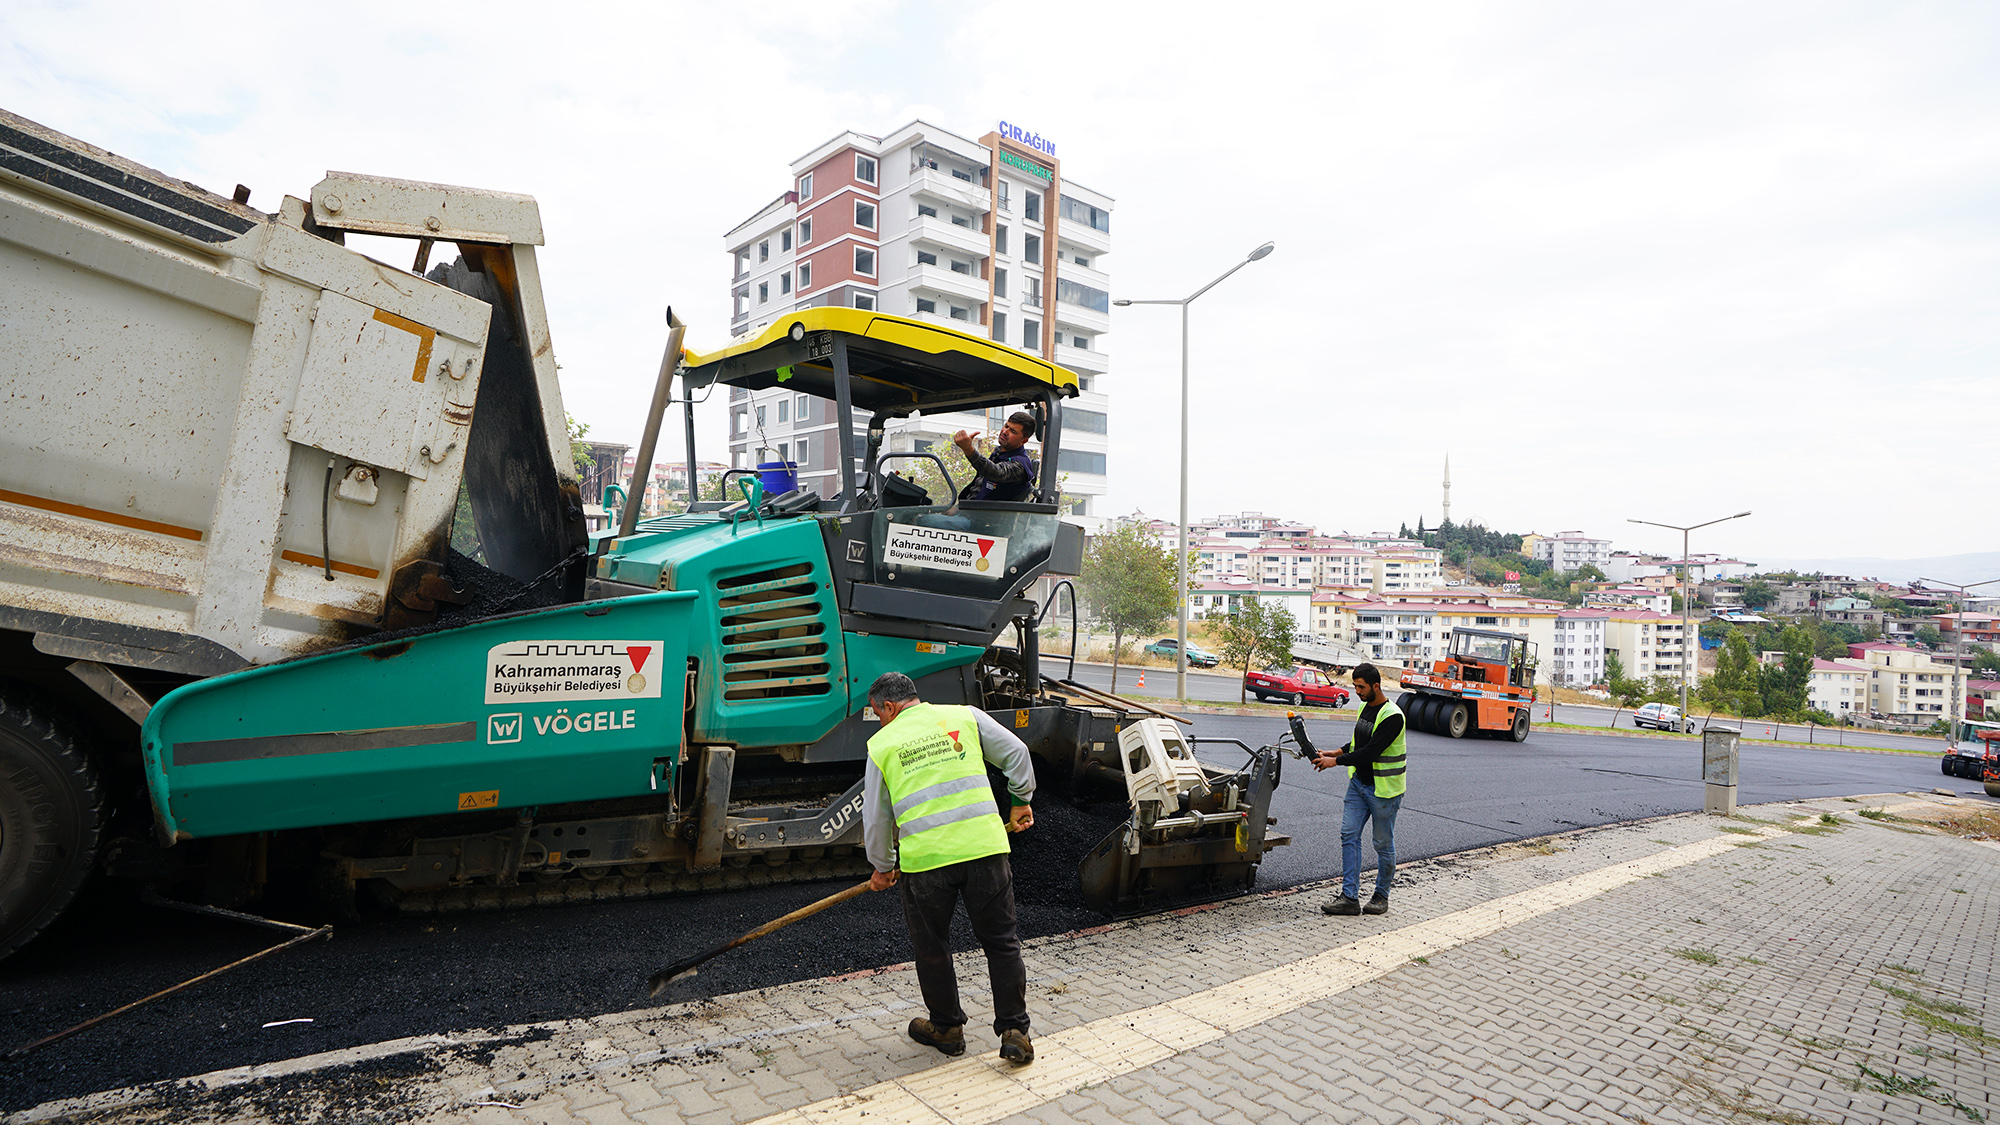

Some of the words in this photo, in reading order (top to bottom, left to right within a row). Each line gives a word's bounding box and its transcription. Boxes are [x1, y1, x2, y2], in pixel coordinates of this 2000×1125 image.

[999, 120, 1056, 156] ÇIRAĞIN
[999, 150, 1054, 182] KORUPARK
[890, 549, 932, 562] Büyükşehir
[933, 555, 972, 567] Belediyesi
[891, 538, 973, 558] Kahramanmaraş
[494, 664, 622, 679] Kahramanmaraş
[494, 681, 562, 695] Büyükşehir
[564, 679, 621, 693] Belediyesi
[532, 708, 636, 736] VÖGELE
[820, 789, 865, 840] SUPE
